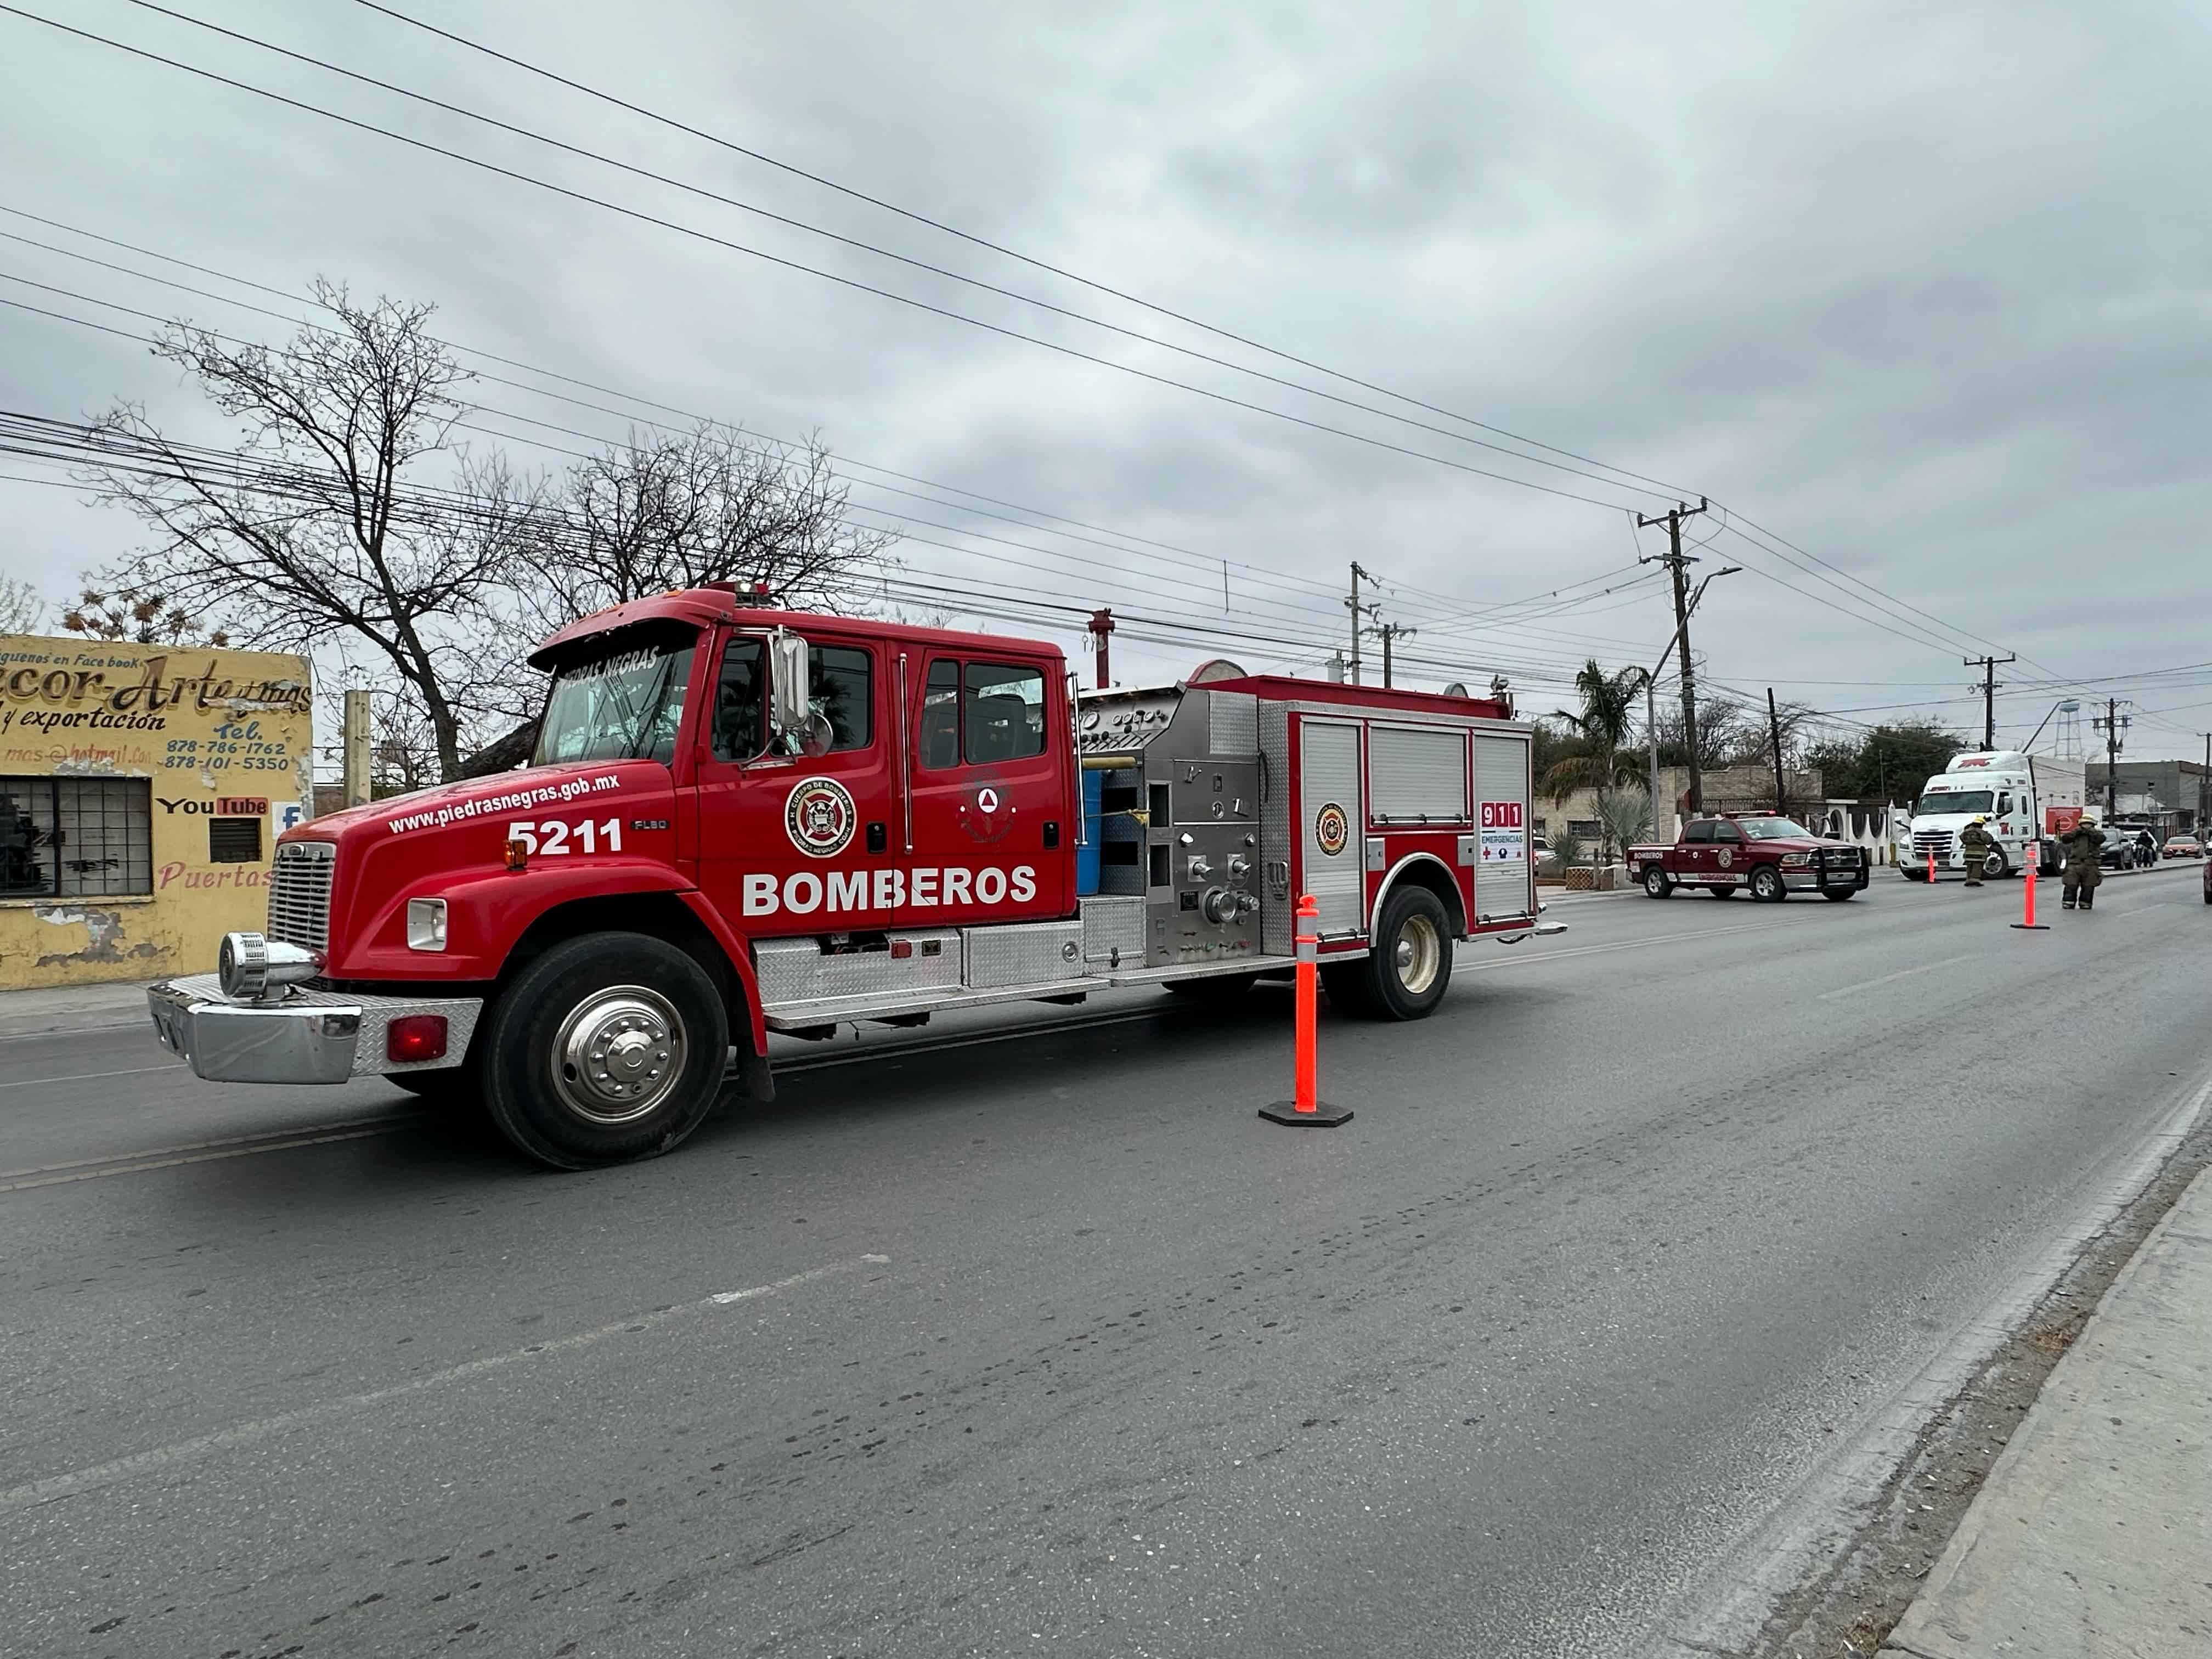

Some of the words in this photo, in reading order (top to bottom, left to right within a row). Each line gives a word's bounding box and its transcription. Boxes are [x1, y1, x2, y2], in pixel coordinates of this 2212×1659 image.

[53, 656, 69, 665] en
[74, 654, 104, 667] Face
[107, 656, 139, 668] book
[602, 645, 660, 678] NEGRAS
[2, 707, 18, 735] y
[20, 707, 166, 734] exportación
[213, 721, 263, 740] Tel.
[166, 740, 286, 755] 878-786-1762
[164, 755, 289, 771] 878-101-5350
[388, 774, 620, 834] www.piedrasnegras.gob.mx
[1483, 806, 1519, 825] 911
[507, 817, 622, 856] 5211
[1481, 835, 1523, 844] EMERGENCIAS
[1633, 851, 1664, 860] BOMBEROS
[157, 861, 273, 890] Puertas
[743, 865, 1036, 916] BOMBEROS
